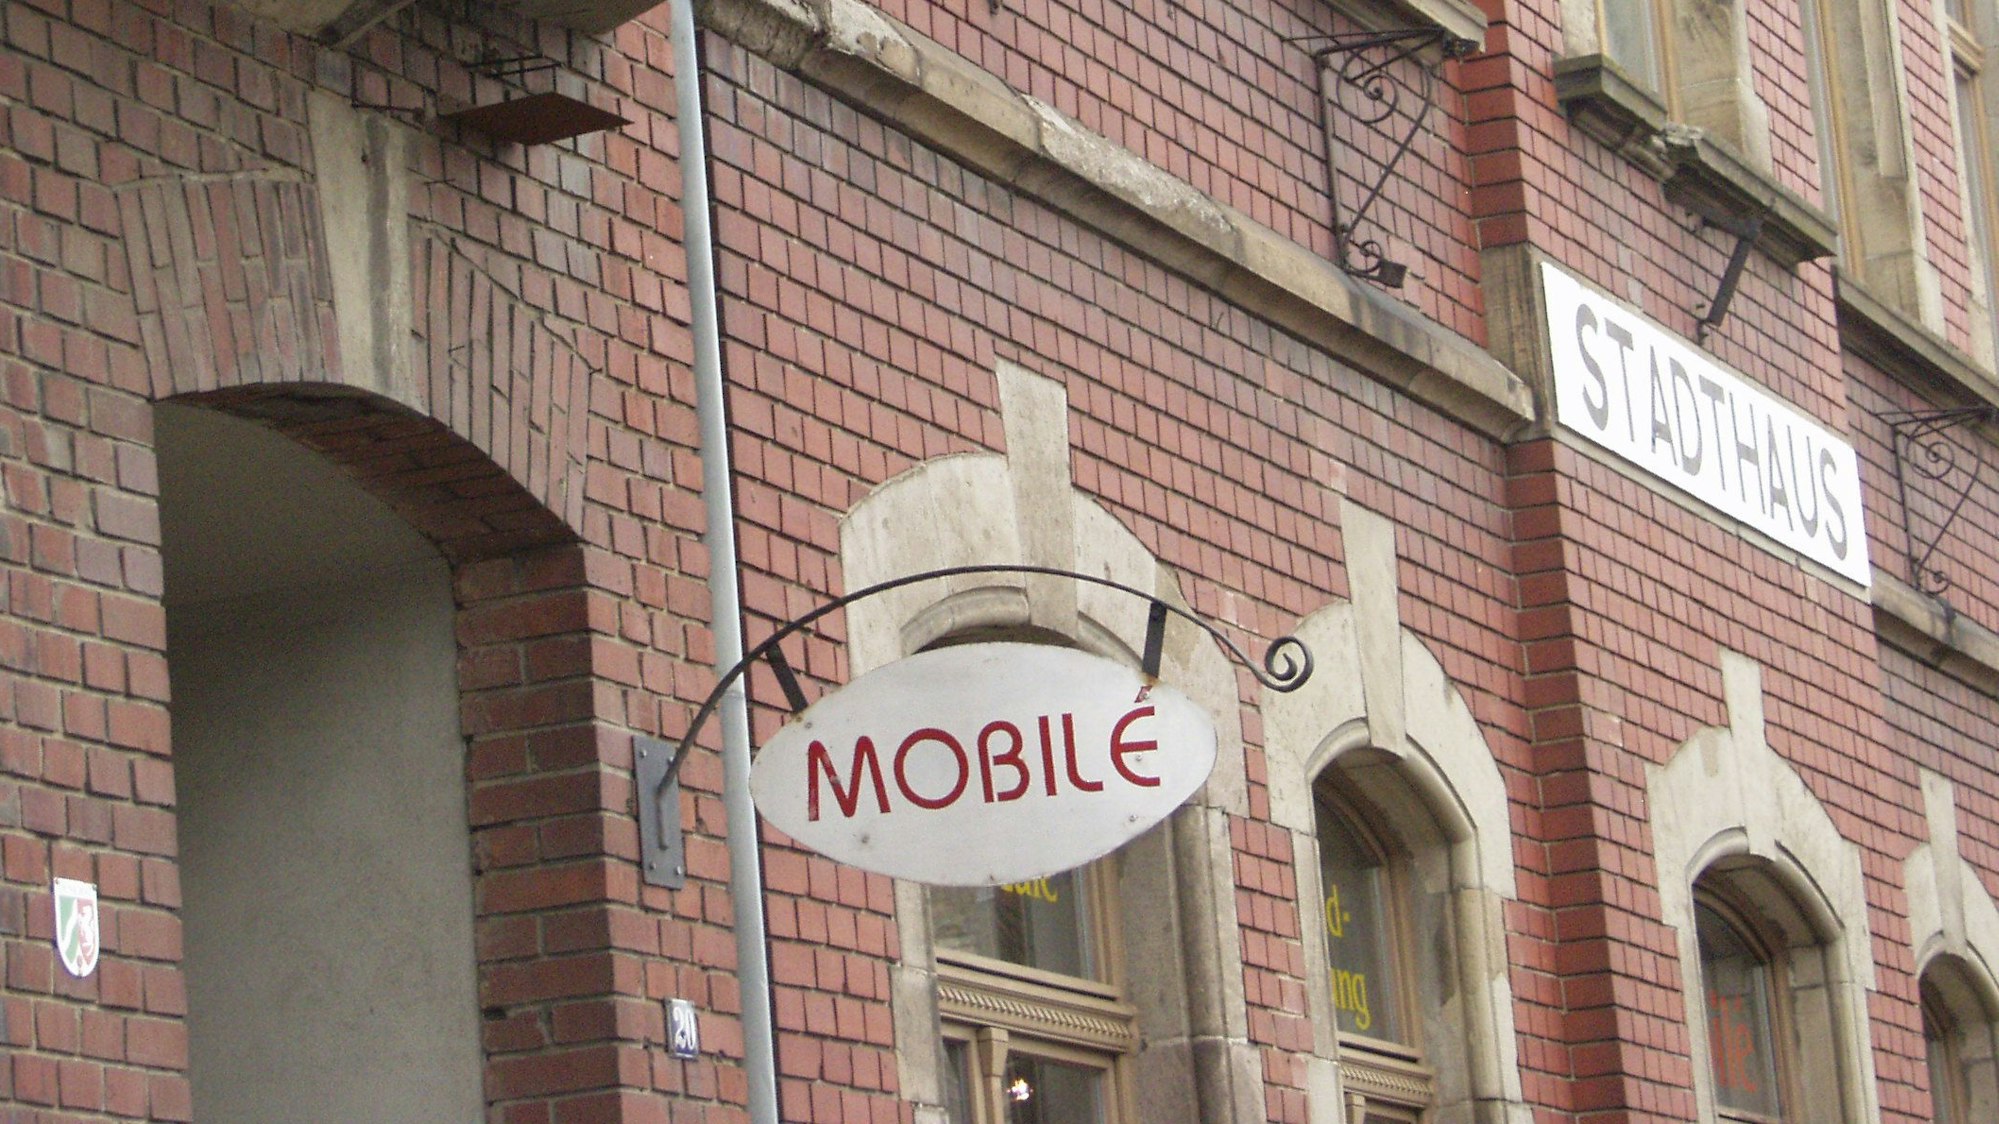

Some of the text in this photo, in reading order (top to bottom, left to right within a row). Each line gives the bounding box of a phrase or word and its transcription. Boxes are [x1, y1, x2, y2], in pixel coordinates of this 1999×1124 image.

[1575, 303, 1848, 561] STADTHAUS
[807, 685, 1161, 822] MOBILÉ
[672, 1005, 698, 1051] 20
[1708, 988, 1757, 1093] ilé
